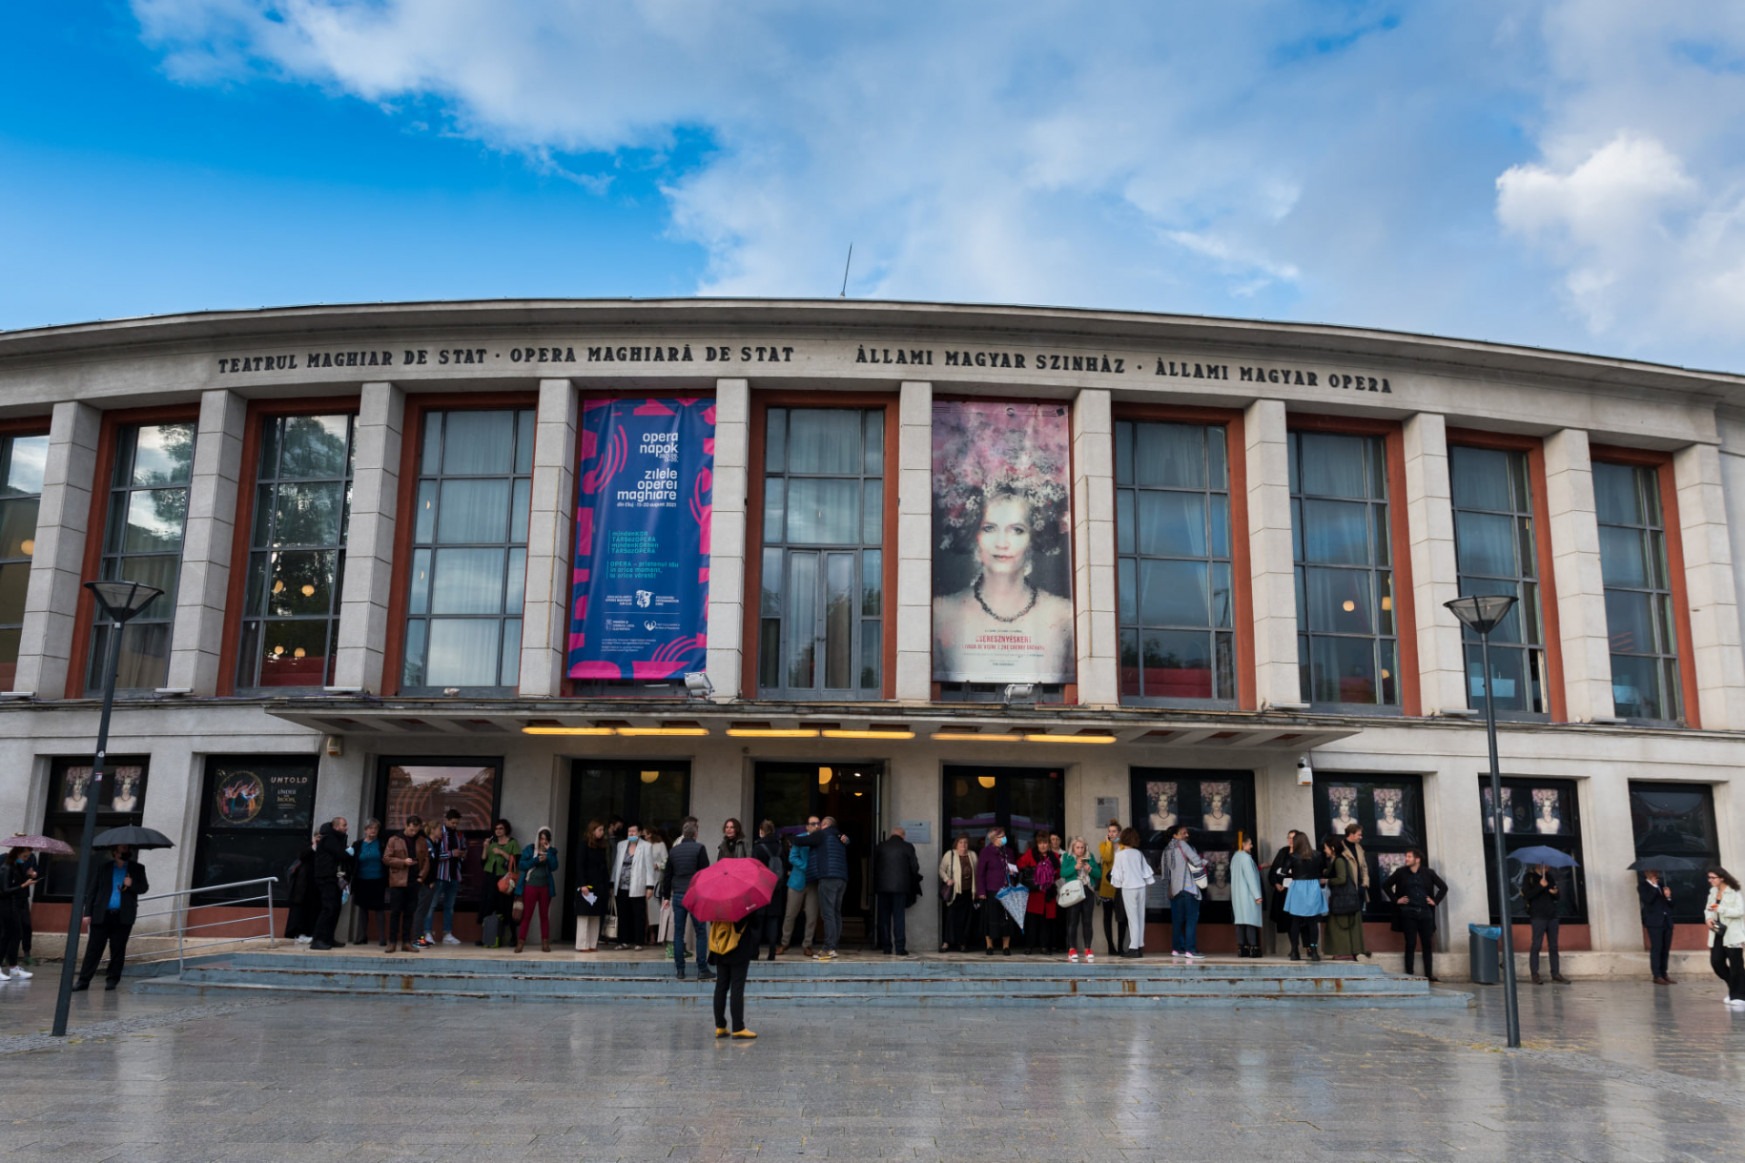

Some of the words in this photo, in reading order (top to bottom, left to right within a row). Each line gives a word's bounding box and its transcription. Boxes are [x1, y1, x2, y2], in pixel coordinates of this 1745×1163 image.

[218, 355, 298, 373] TEATRUL
[306, 351, 393, 368] MAGHIAR
[403, 350, 428, 365] DE
[438, 349, 487, 365] STAT
[510, 347, 577, 363] OPERA
[705, 346, 731, 362] DE
[740, 346, 794, 362] STAT
[944, 351, 1027, 368] MAGYAR
[1239, 366, 1318, 386] MAGYAR
[1328, 374, 1392, 393] OPERA
[642, 432, 679, 443] opera
[639, 442, 679, 457] napok
[617, 489, 677, 502] maghiare
[270, 776, 308, 784] UNTOLD
